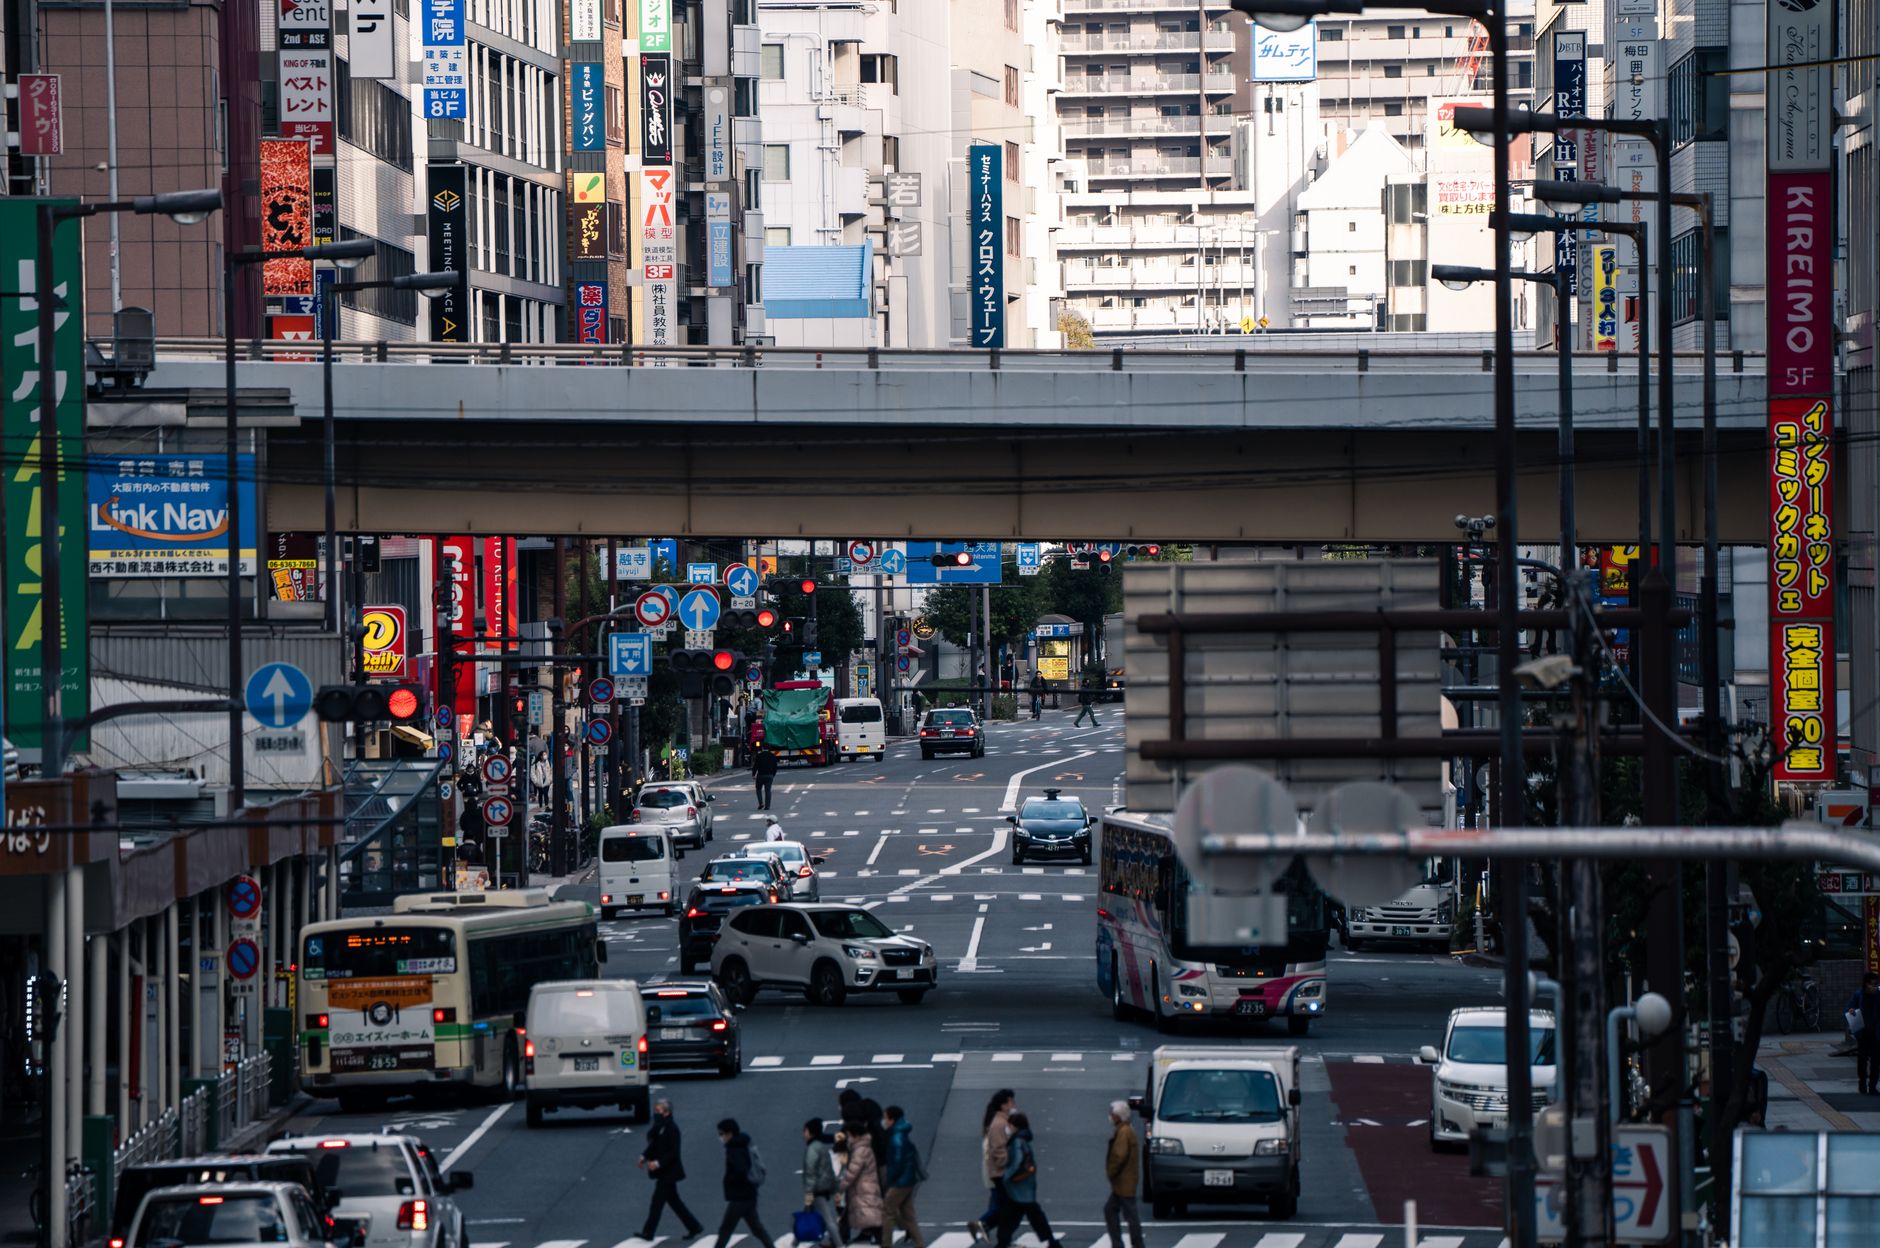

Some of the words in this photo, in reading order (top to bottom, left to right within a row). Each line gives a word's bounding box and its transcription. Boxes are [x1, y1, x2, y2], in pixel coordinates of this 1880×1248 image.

[284, 34, 300, 44] 2nd
[645, 35, 665, 47] 2F
[426, 50, 462, 59] 建築士
[1258, 44, 1310, 58] サムティ
[1624, 45, 1648, 57] 梅田
[283, 60, 299, 68] KING
[300, 60, 309, 68] OF
[310, 60, 327, 68] 不動産
[284, 77, 327, 92] ベスト
[426, 76, 463, 84] 施工管理
[430, 91, 459, 99] 当ビル
[286, 97, 328, 113] レント
[431, 101, 460, 116] 8F
[582, 89, 595, 147] ビッグバン
[295, 125, 319, 133] 当ビル
[712, 115, 724, 175] JFE設計
[1630, 154, 1643, 162] 4F
[980, 154, 992, 222] セミナーハウス
[1631, 175, 1643, 223] Execise
[889, 175, 920, 254] 若杉
[587, 209, 600, 241] びっくり
[581, 217, 591, 254] ドンキー
[644, 227, 673, 239] 模型
[443, 222, 452, 271] MEETING
[1558, 229, 1577, 267] 本店
[647, 265, 671, 278] 3F
[1786, 186, 1814, 354] KIREIMO
[581, 285, 602, 306] 薬
[1786, 368, 1815, 386] 5F
[112, 482, 210, 493] 大阪市内の不動産物件
[1803, 400, 1830, 599] インターネット
[91, 501, 158, 531] Link
[1774, 422, 1802, 613] コミックカフェ
[218, 563, 248, 573] 梅店
[617, 567, 640, 576] aiyuji
[355, 1029, 429, 1042] エイズィーホーム
